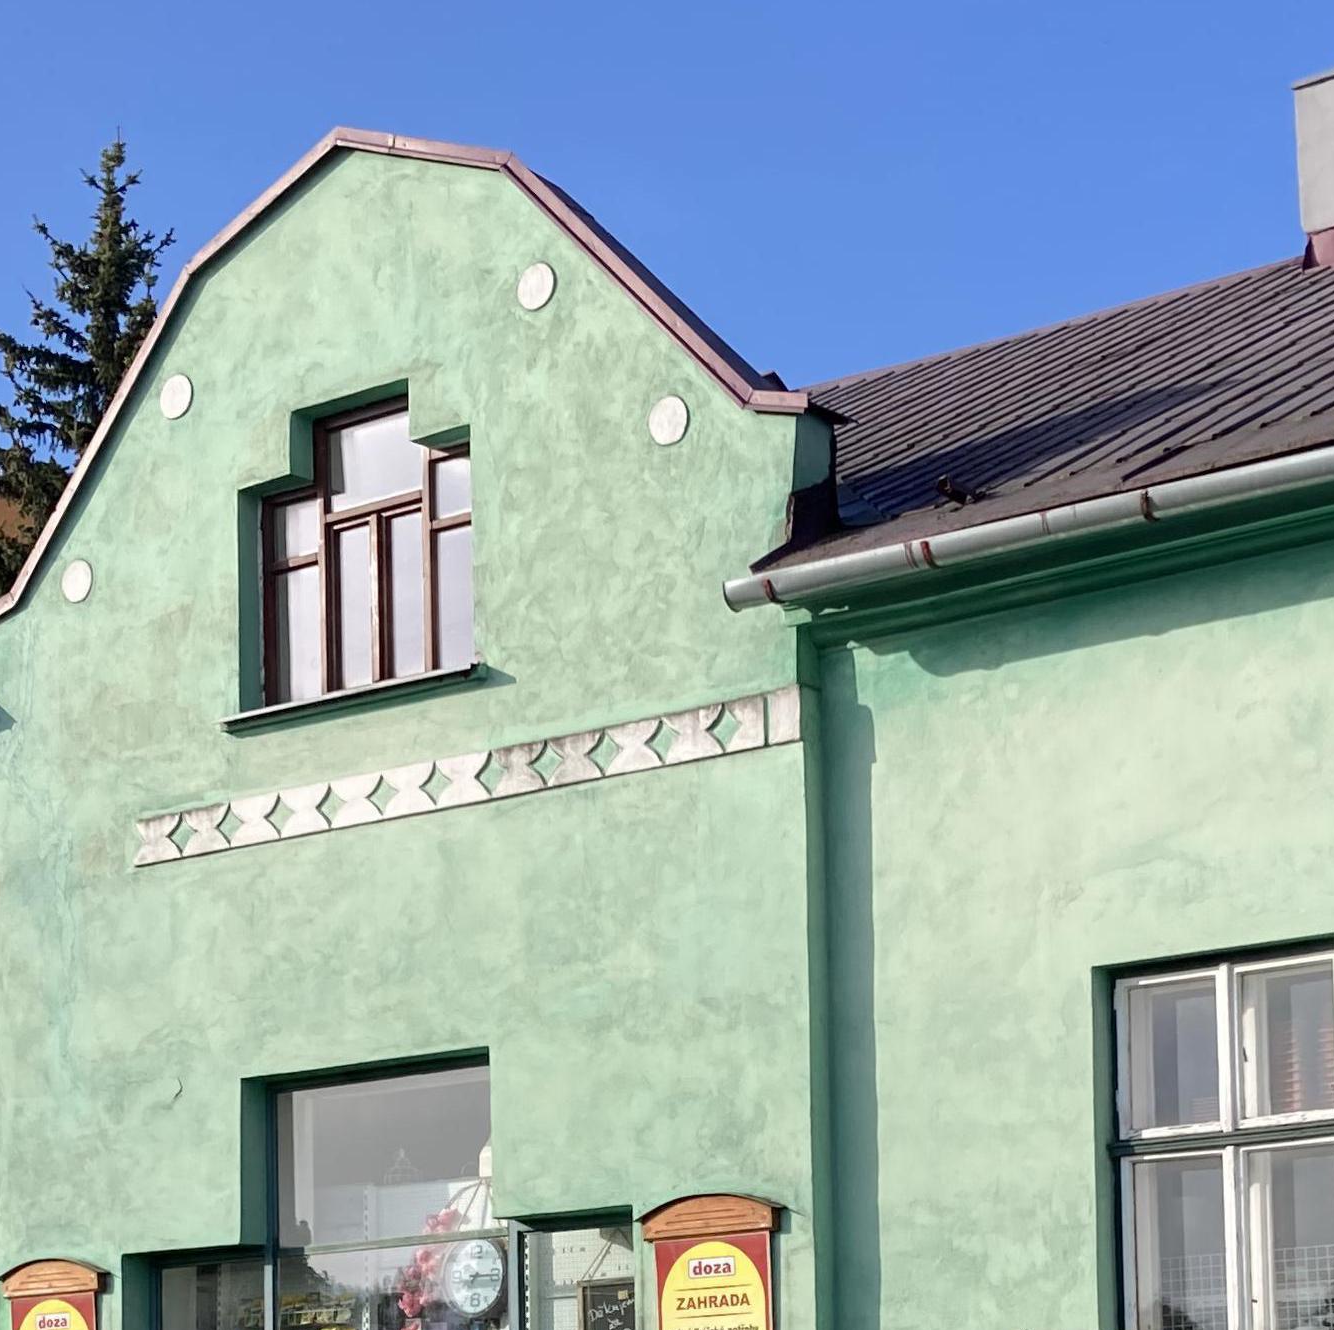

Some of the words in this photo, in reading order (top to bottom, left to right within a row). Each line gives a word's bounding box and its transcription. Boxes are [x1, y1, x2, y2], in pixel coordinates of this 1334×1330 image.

[470, 1245, 483, 1259] 12
[490, 1267, 501, 1282] 3
[692, 1260, 732, 1276] doza
[676, 1292, 751, 1311] ZAHRADA
[38, 1316, 68, 1329] doza
